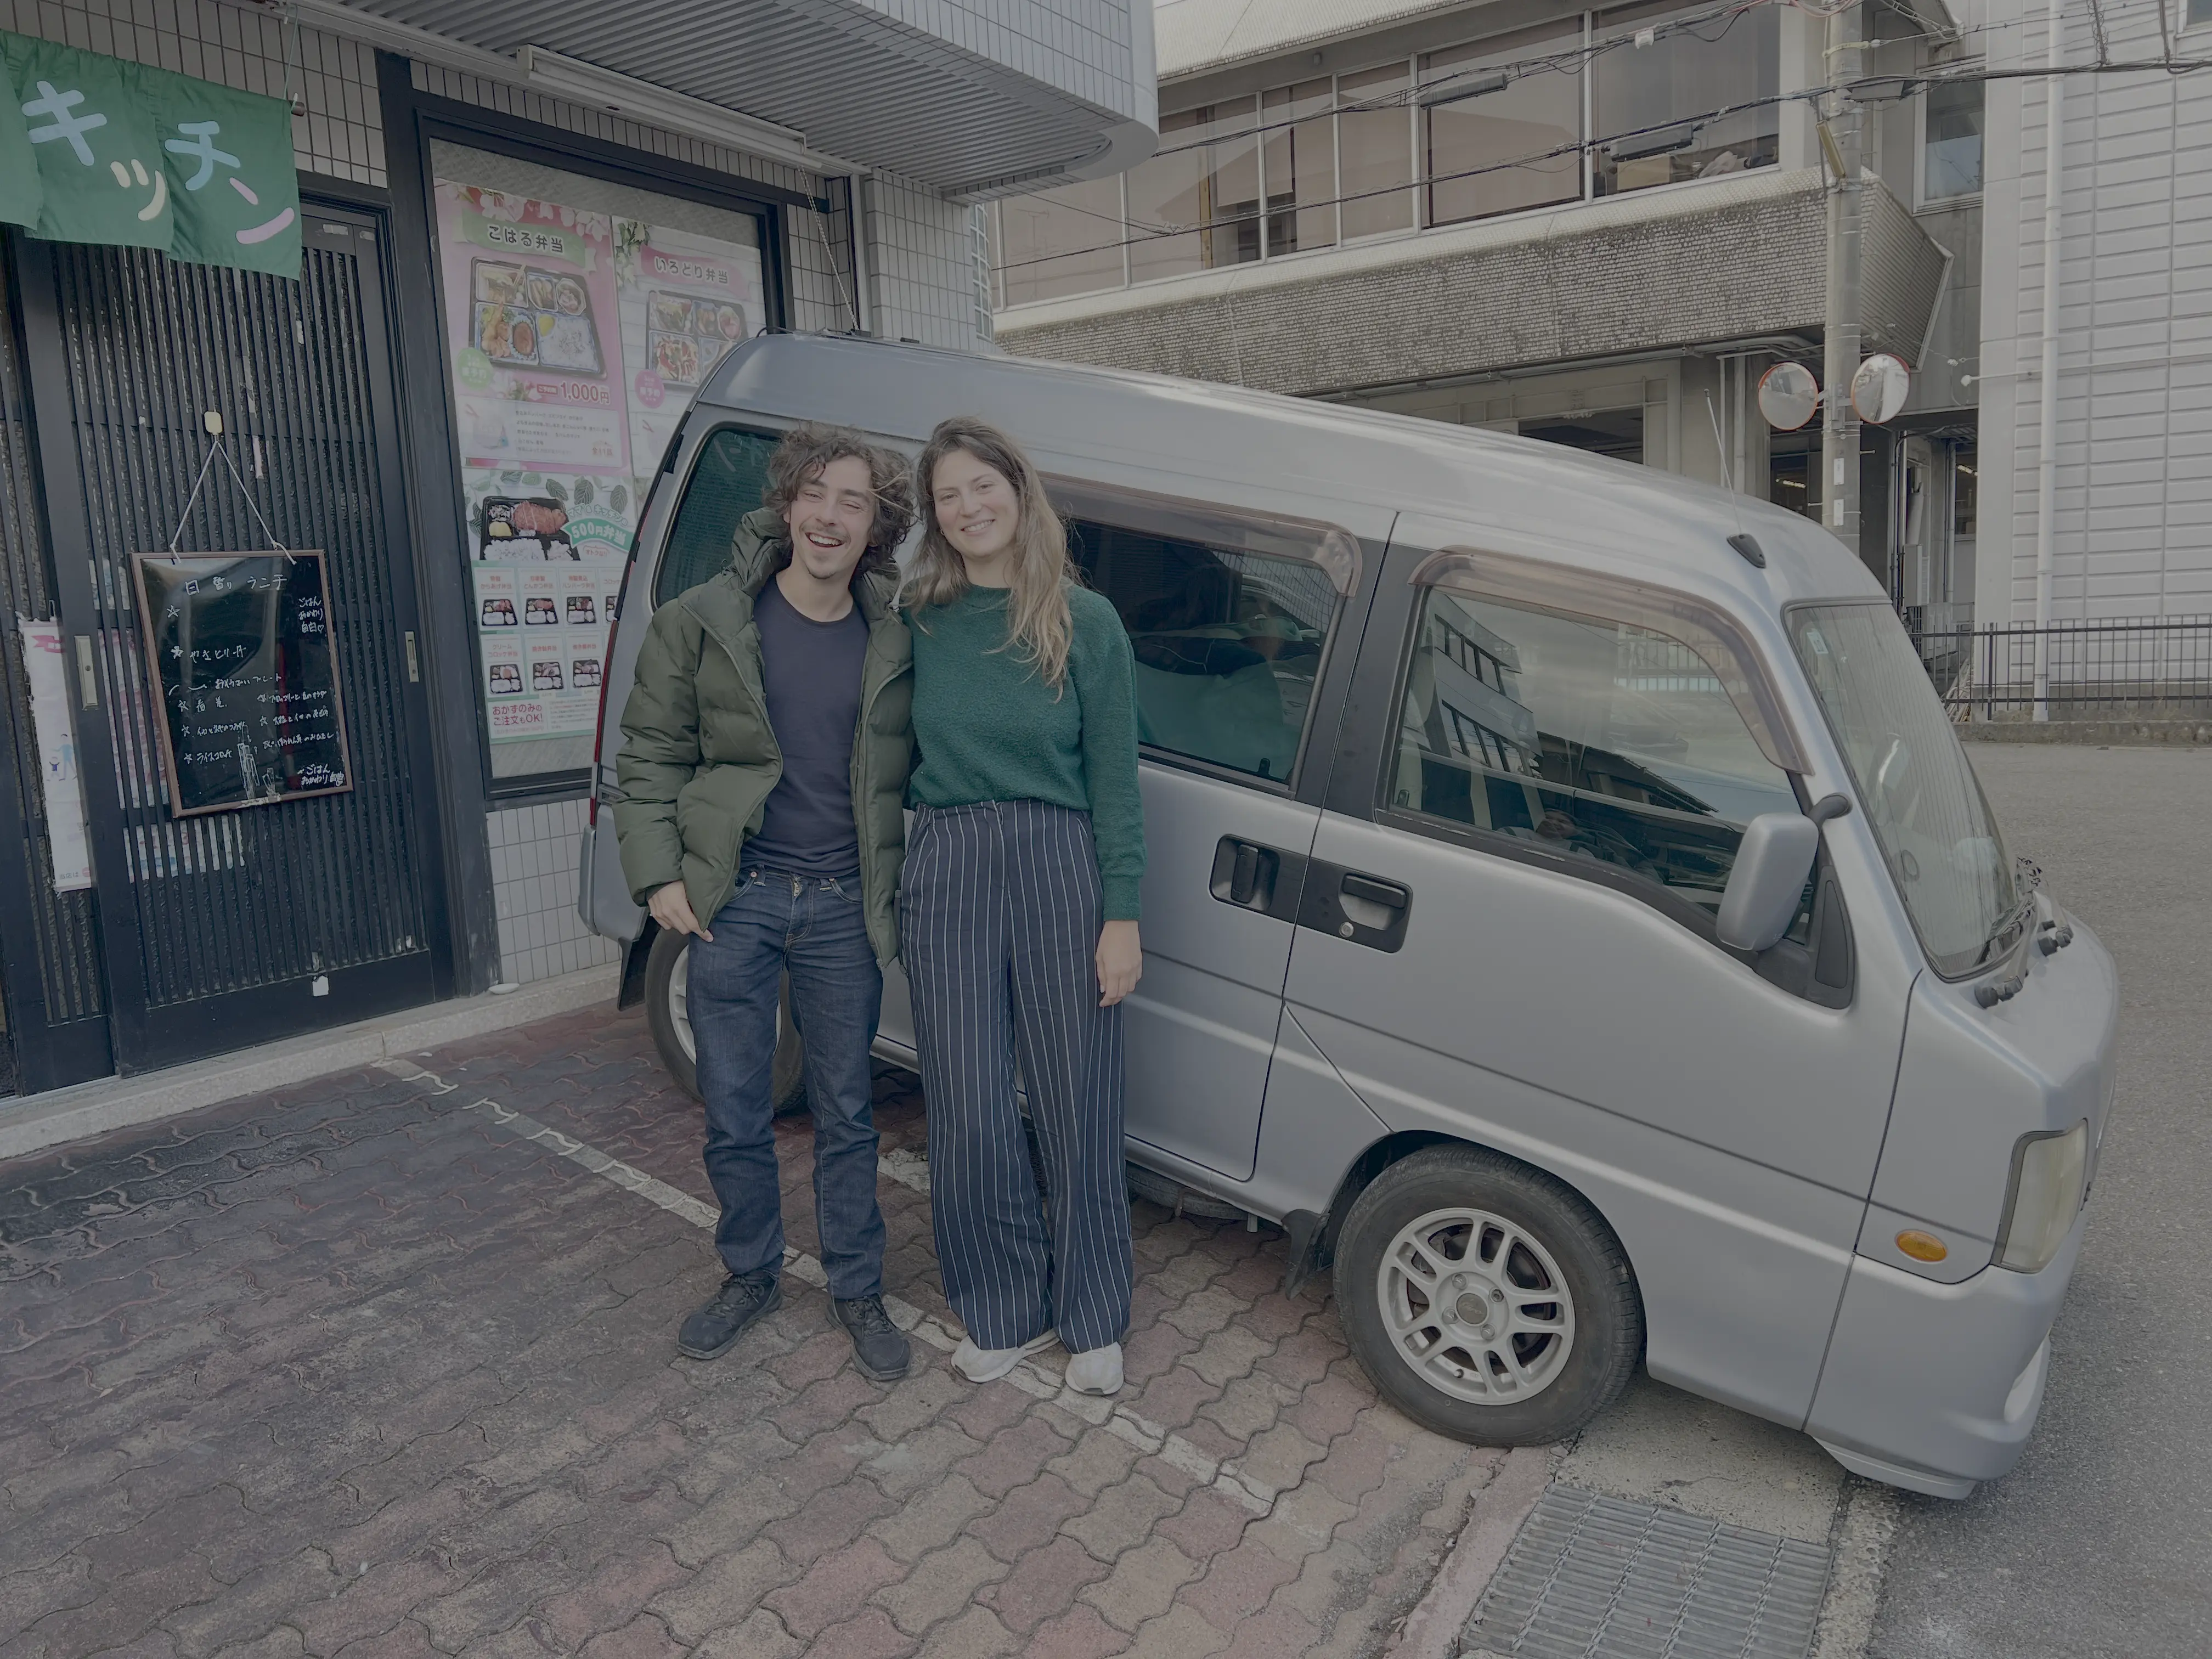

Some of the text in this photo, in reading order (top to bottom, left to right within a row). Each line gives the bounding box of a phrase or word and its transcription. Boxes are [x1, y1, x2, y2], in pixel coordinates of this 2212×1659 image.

[22, 81, 295, 244] キッチン
[487, 223, 565, 254] こはる弁当
[653, 256, 730, 284] いろどり弁当
[561, 381, 610, 403] 1,000円
[571, 521, 627, 546] 500円弁当
[298, 596, 321, 607] ごはん
[492, 703, 543, 715] おかずのみの
[493, 713, 543, 726] ご注文もOK!
